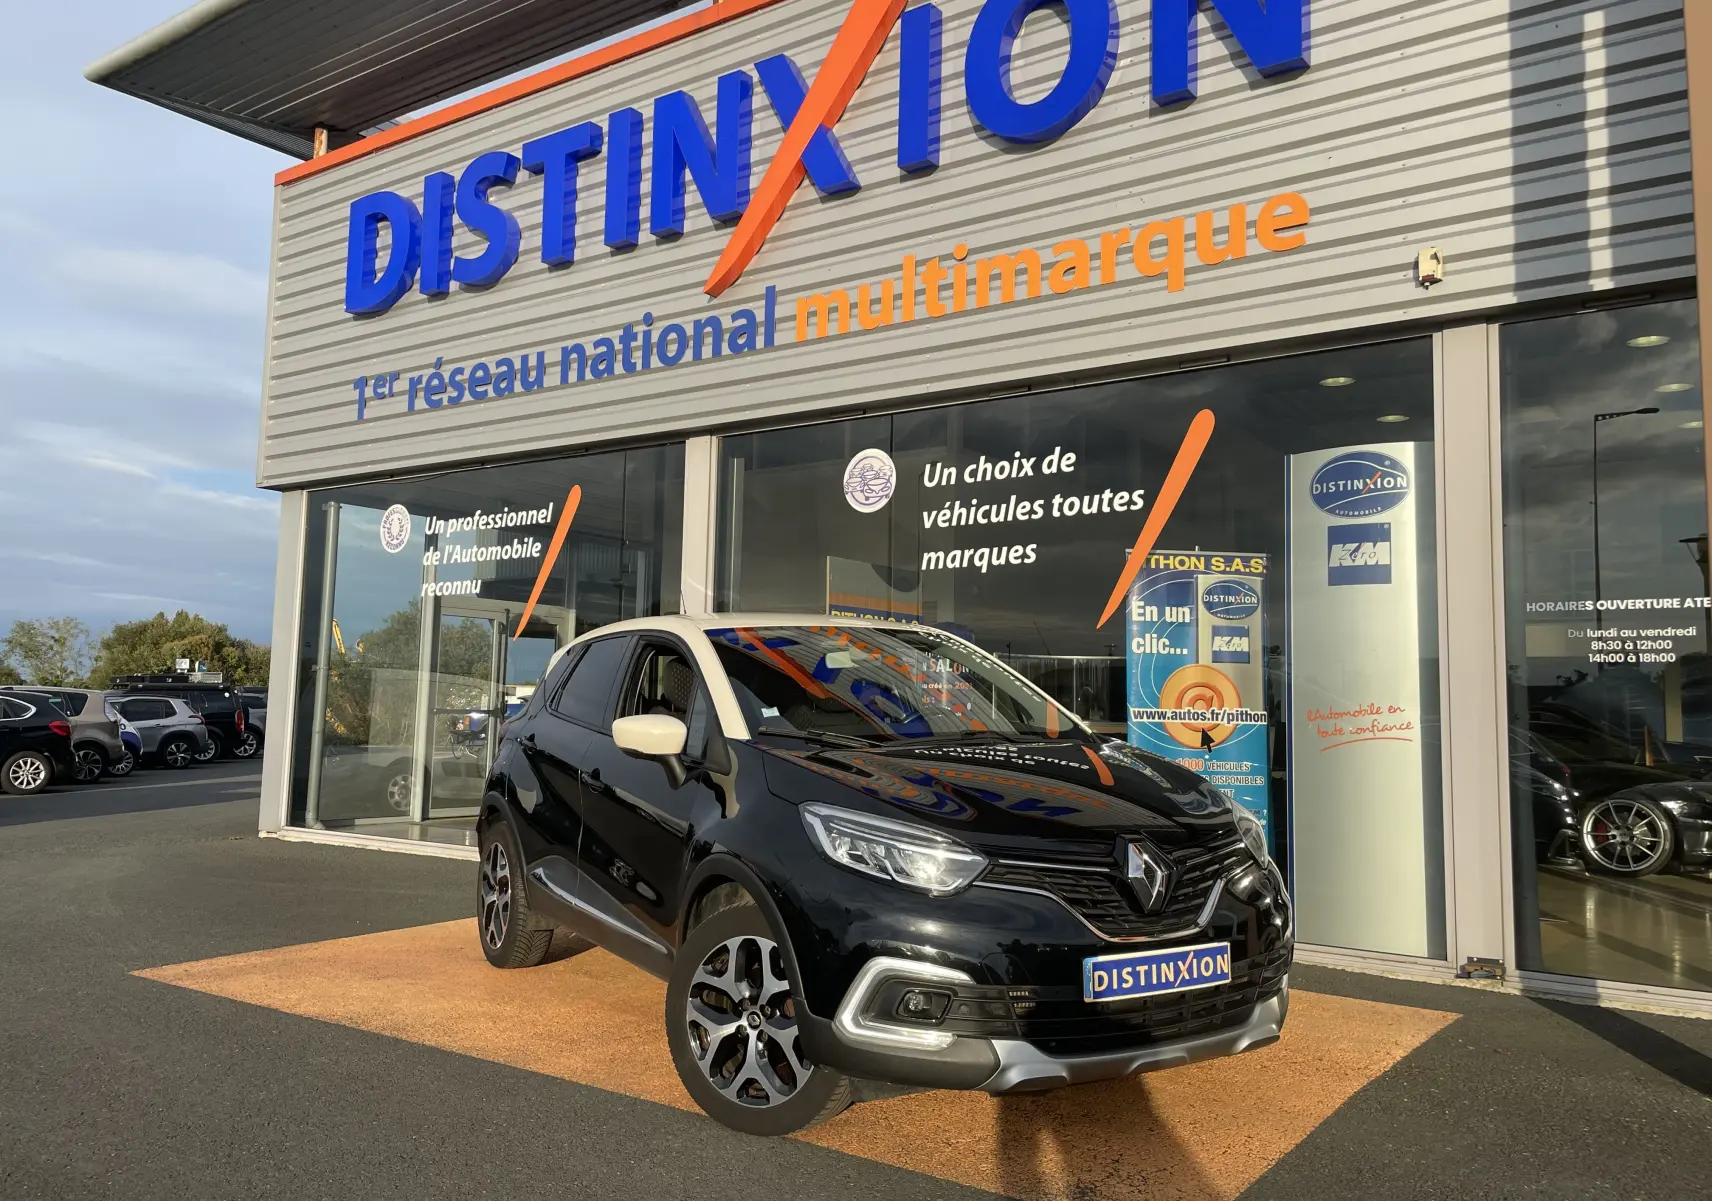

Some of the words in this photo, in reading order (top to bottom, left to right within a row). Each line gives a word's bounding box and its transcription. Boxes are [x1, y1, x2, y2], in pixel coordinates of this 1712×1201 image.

[345, 0, 1311, 316] DISTINXION
[353, 371, 399, 421] 1er
[407, 350, 546, 412] réseau
[560, 284, 778, 389] national
[794, 191, 1311, 343] multimarque
[923, 461, 956, 488] Un
[964, 451, 1036, 483] choix
[1042, 446, 1077, 475] de
[1312, 471, 1408, 495] DISTINXION
[425, 515, 444, 536] Un
[447, 502, 554, 537] professionnel
[922, 494, 1044, 529] véhicules
[1051, 488, 1145, 518] toutes
[1335, 506, 1382, 516] AUTOMOBILE
[423, 548, 440, 566] de
[443, 537, 542, 564] l'Automobile
[921, 542, 1037, 574] marques
[1328, 541, 1391, 567] KM
[421, 578, 481, 597] reconnu
[1203, 592, 1258, 605] DISTINXION
[1132, 600, 1158, 621] En
[1165, 606, 1190, 622] un
[1526, 600, 1594, 612] HORAIRES
[1596, 598, 1681, 610] OUVERTURE
[1683, 597, 1712, 608] ATE
[1568, 629, 1584, 638] Du
[1586, 627, 1617, 638] lundi
[1620, 629, 1637, 637] au
[1639, 626, 1697, 637] vendredi
[1132, 633, 1188, 655] clic...
[1591, 640, 1622, 650] 8h30
[1624, 640, 1634, 650] à
[1636, 640, 1673, 650] 12h00
[1588, 653, 1624, 663] 14h00
[1627, 652, 1636, 663] à
[1639, 653, 1676, 663] 18h00
[1133, 709, 1267, 725] www.autos.fr/pithon
[1388, 704, 1406, 714] en
[1317, 722, 1345, 738] toute
[1349, 718, 1414, 736] confiance
[1212, 776, 1264, 785] DISPONIBLES
[1094, 950, 1229, 992] DISTINXION
